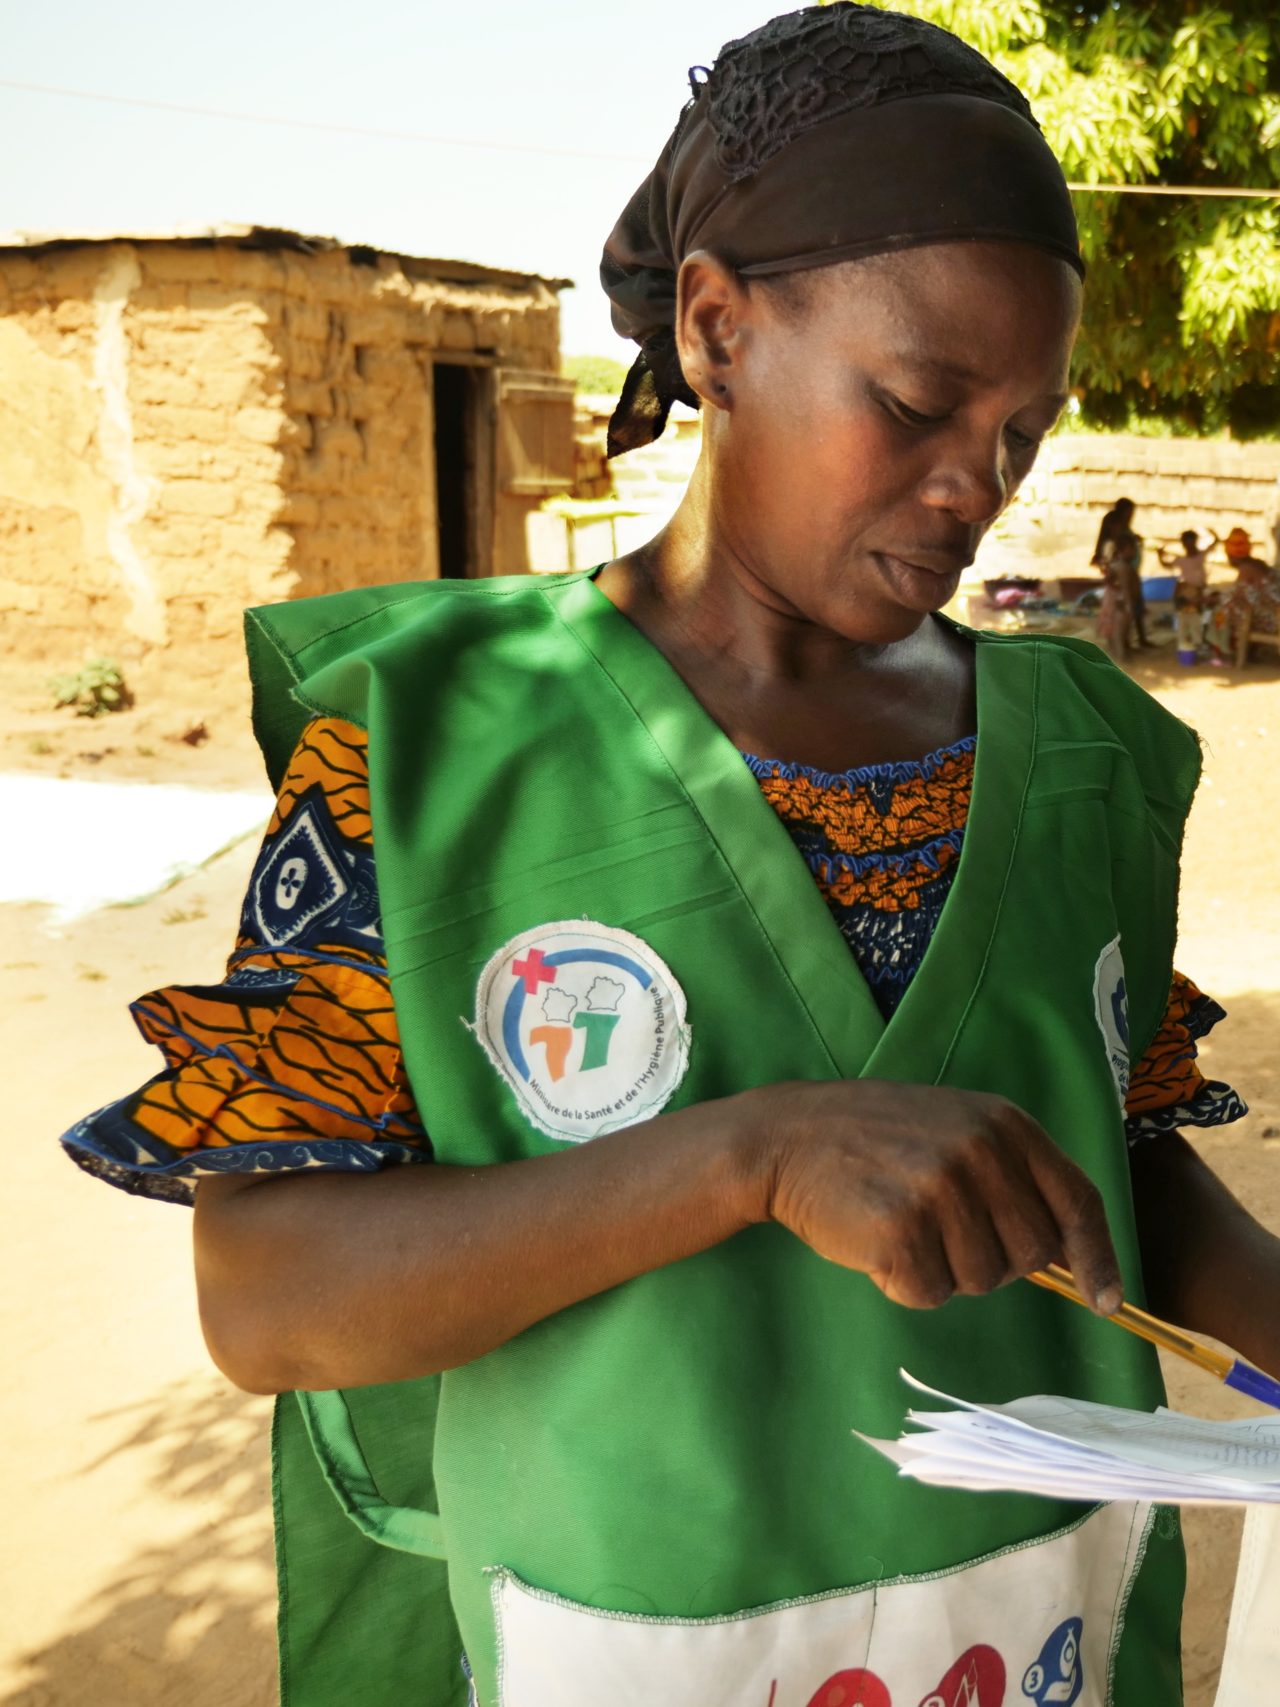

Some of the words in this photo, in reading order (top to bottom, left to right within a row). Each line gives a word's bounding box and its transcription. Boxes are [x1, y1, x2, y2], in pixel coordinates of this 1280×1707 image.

[562, 1108, 573, 1118] de
[575, 1110, 582, 1119] la
[584, 1104, 613, 1120] Santé
[614, 1099, 626, 1110] et
[625, 1089, 638, 1101] de
[650, 986, 664, 1034] Publique
[1029, 1671, 1039, 1689] 3
